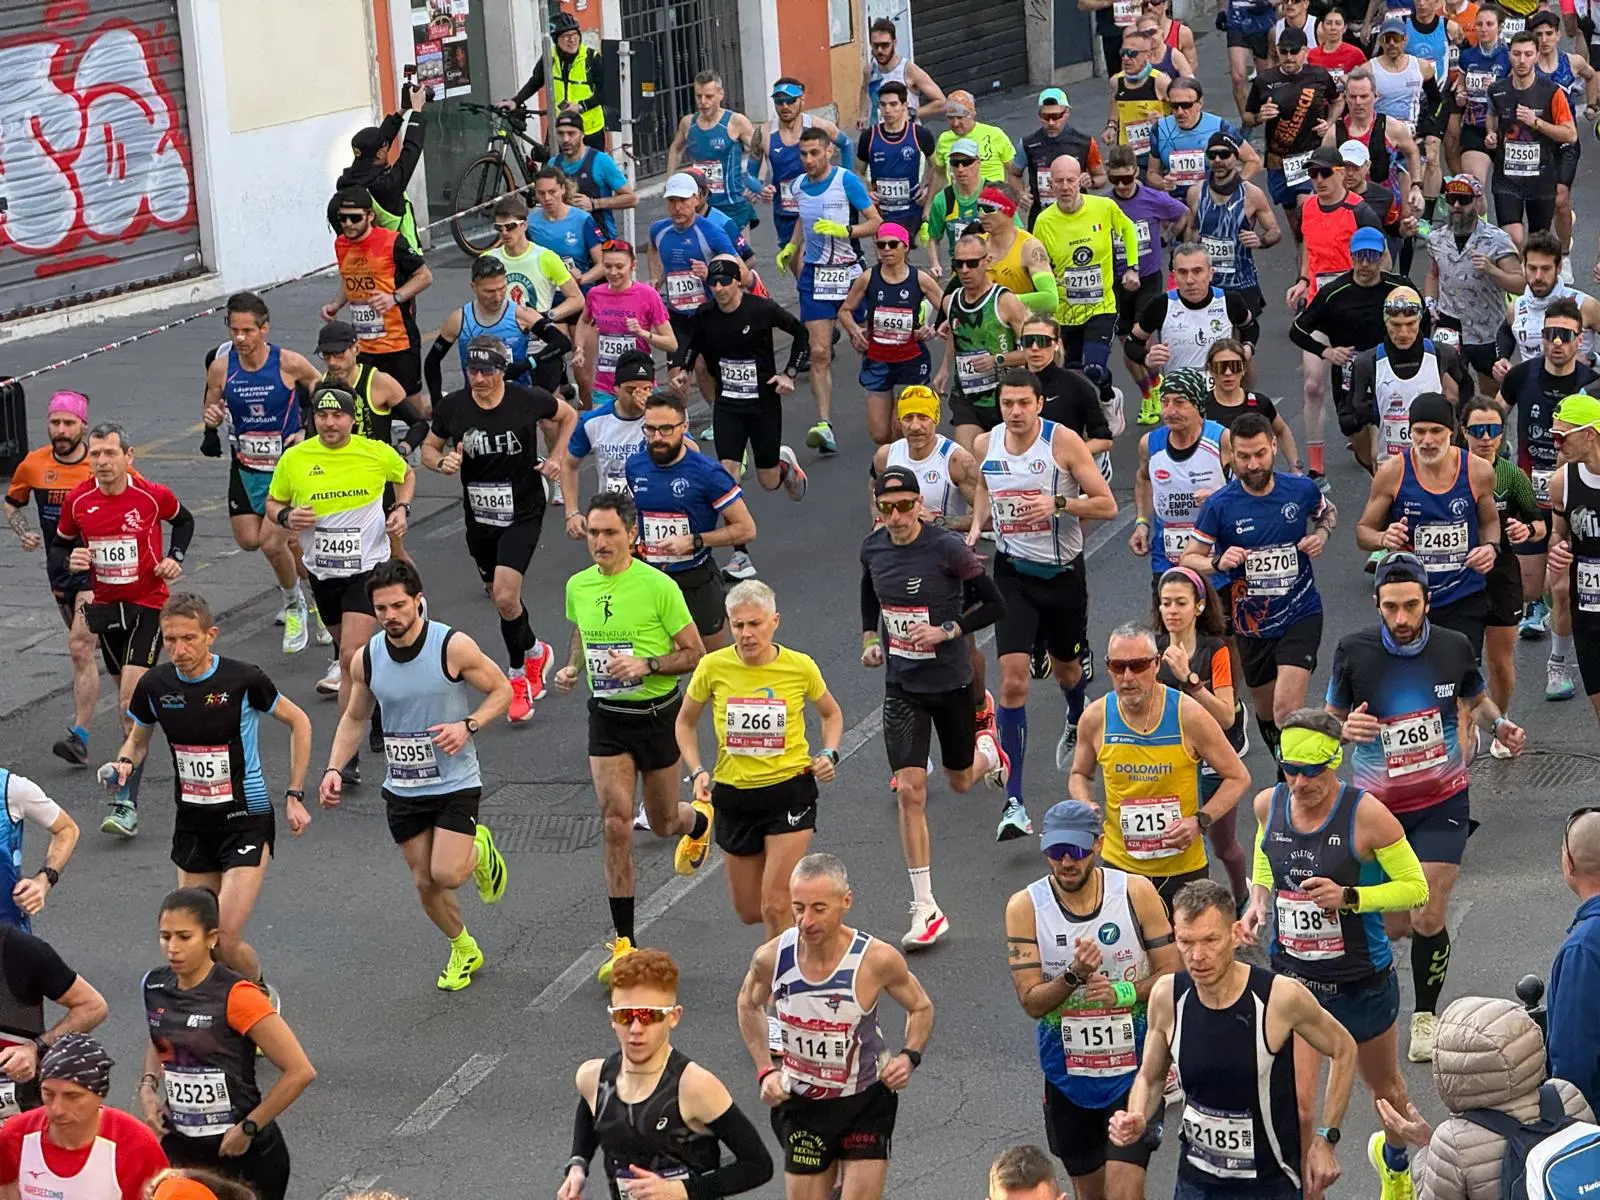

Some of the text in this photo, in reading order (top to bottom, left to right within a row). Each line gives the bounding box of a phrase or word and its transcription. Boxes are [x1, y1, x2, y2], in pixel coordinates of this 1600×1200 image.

[1510, 148, 1534, 160] 2550
[1178, 158, 1196, 170] 170
[880, 183, 904, 196] 2311
[1068, 237, 1093, 246] BRESCIA
[819, 269, 845, 284] 2226
[1070, 274, 1096, 288] 2719
[676, 281, 694, 293] 130
[883, 317, 903, 329] 659
[604, 341, 630, 355] 2584
[725, 368, 750, 381] 2236
[250, 441, 271, 454] 125
[310, 488, 370, 501] ATLETICACIMA
[476, 493, 505, 508] 2184
[322, 539, 354, 554] 2449
[1424, 532, 1460, 548] 2483
[101, 546, 126, 562] 168
[1254, 555, 1290, 573] 2570
[1436, 690, 1454, 698] CLUB
[741, 712, 771, 730] 266
[1397, 724, 1429, 746] 268
[392, 744, 425, 762] 2595
[189, 760, 215, 779] 105
[1134, 812, 1167, 832] 215
[1291, 909, 1323, 931] 138
[1079, 1025, 1114, 1047] 151
[795, 1036, 828, 1060] 114
[174, 1083, 216, 1103] 2523
[1192, 1123, 1240, 1150] 2185
